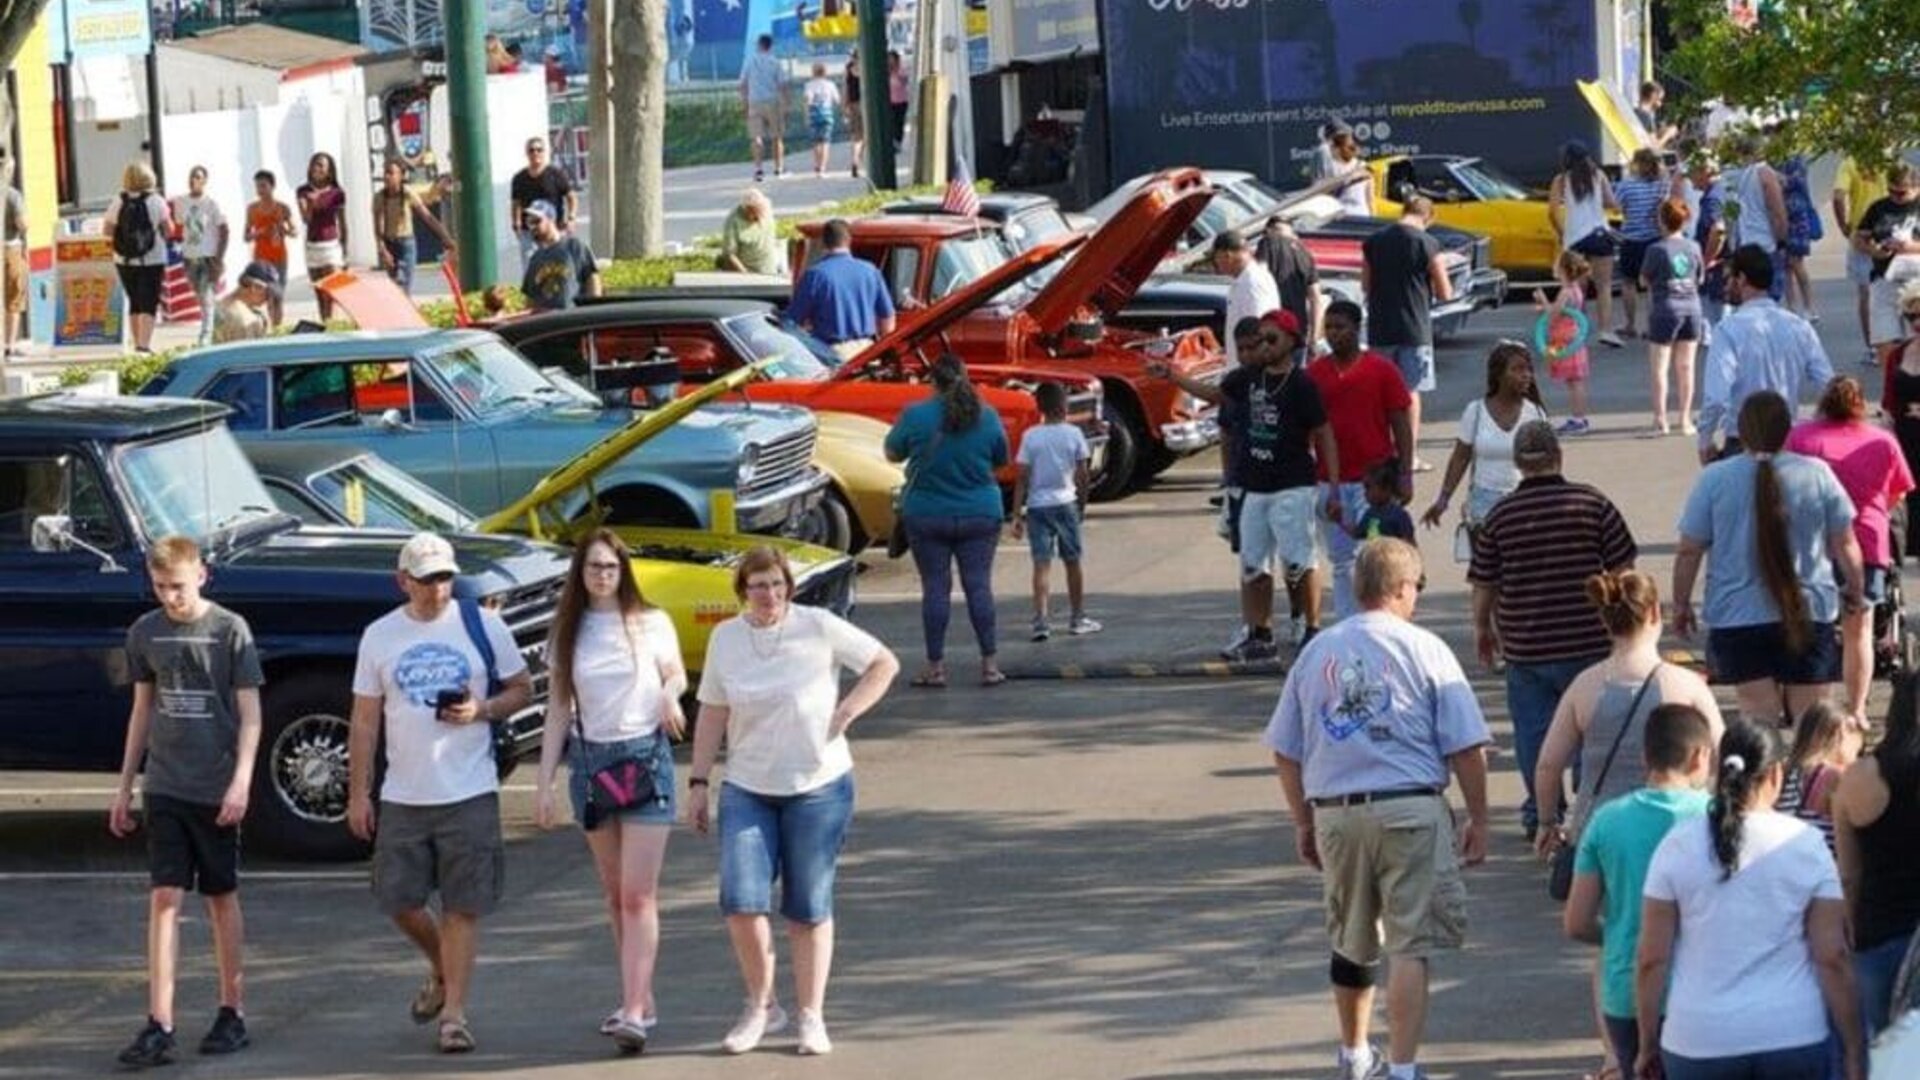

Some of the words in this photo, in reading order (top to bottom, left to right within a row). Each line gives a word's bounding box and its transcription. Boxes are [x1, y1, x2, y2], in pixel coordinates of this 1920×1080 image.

[1161, 112, 1191, 128] Live
[1193, 108, 1300, 126] Entertainment
[1302, 103, 1372, 120] Schedule
[1373, 103, 1388, 117] at
[1391, 97, 1546, 118] myoldtownusa.com
